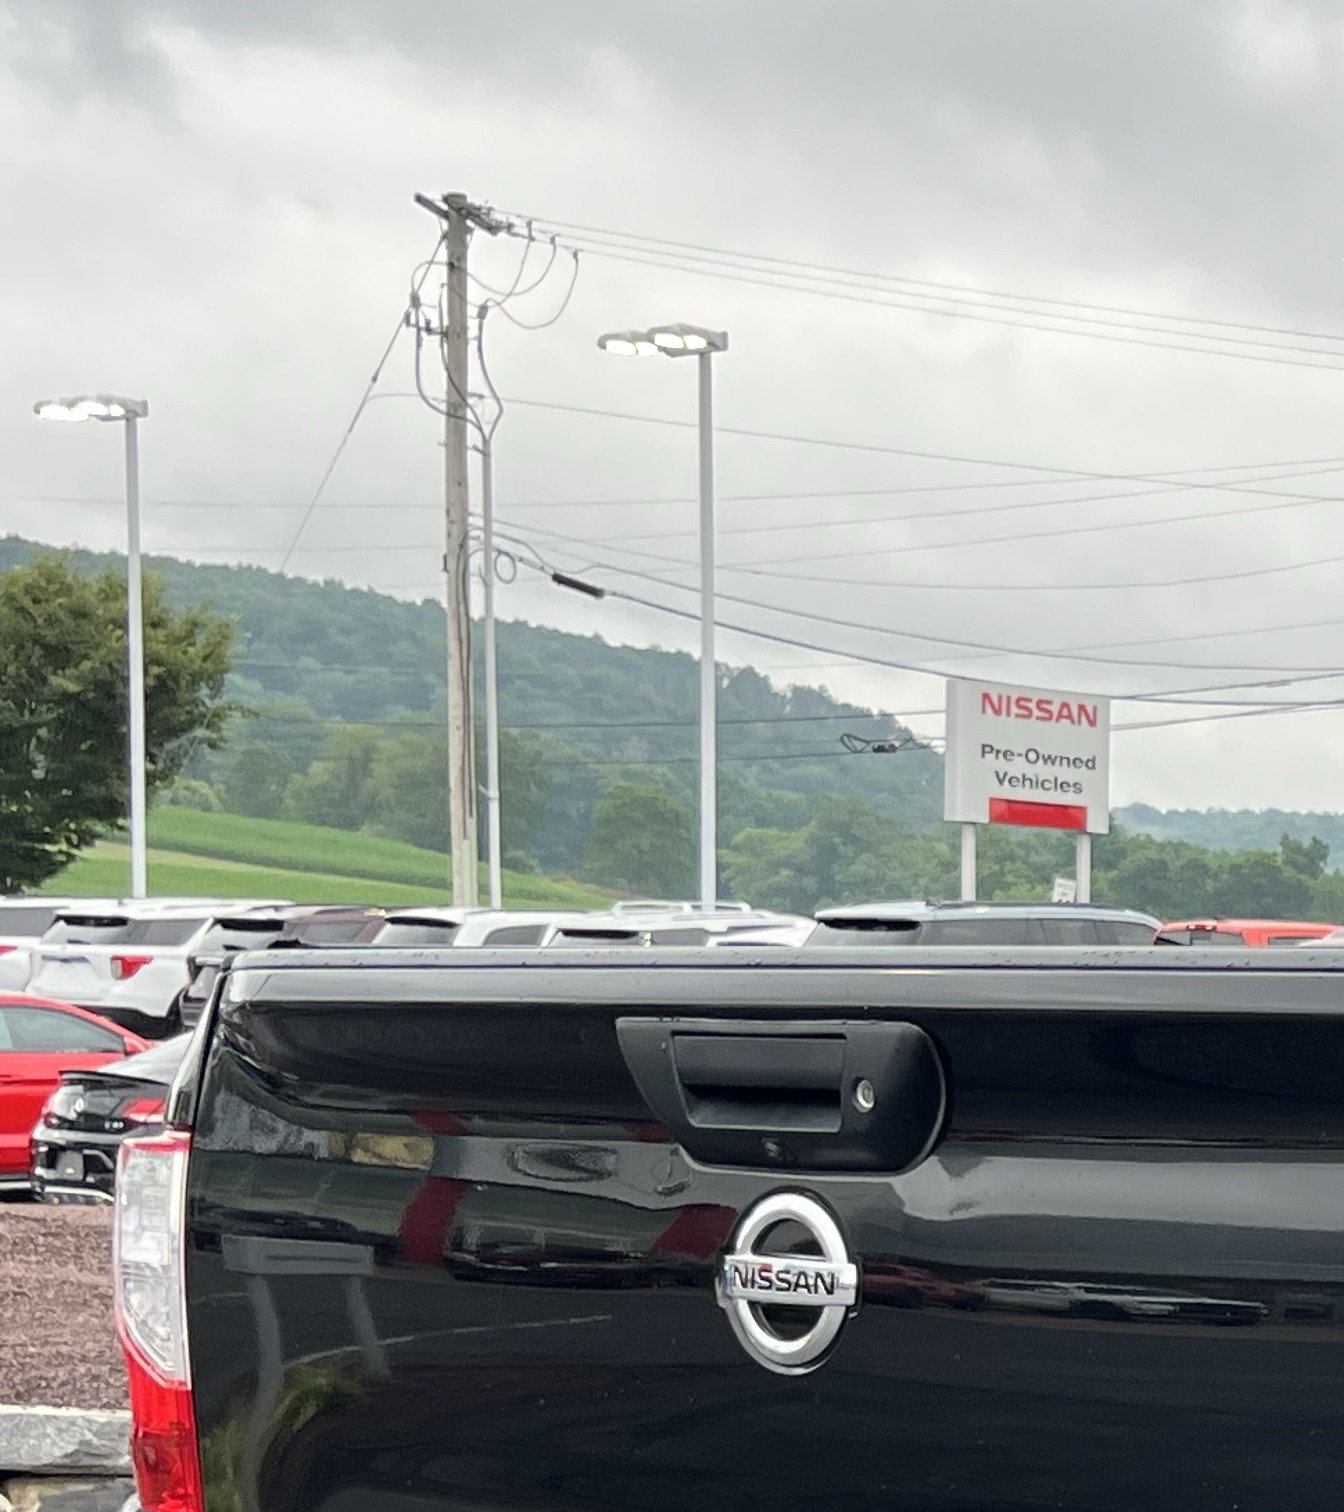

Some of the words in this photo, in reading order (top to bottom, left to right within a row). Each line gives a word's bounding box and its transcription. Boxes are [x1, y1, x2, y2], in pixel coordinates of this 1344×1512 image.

[980, 691, 1098, 728] NISSAN
[980, 743, 1096, 771] Pre-Owned
[995, 770, 1084, 795] Vehicles
[731, 1264, 835, 1296] NISSAN
